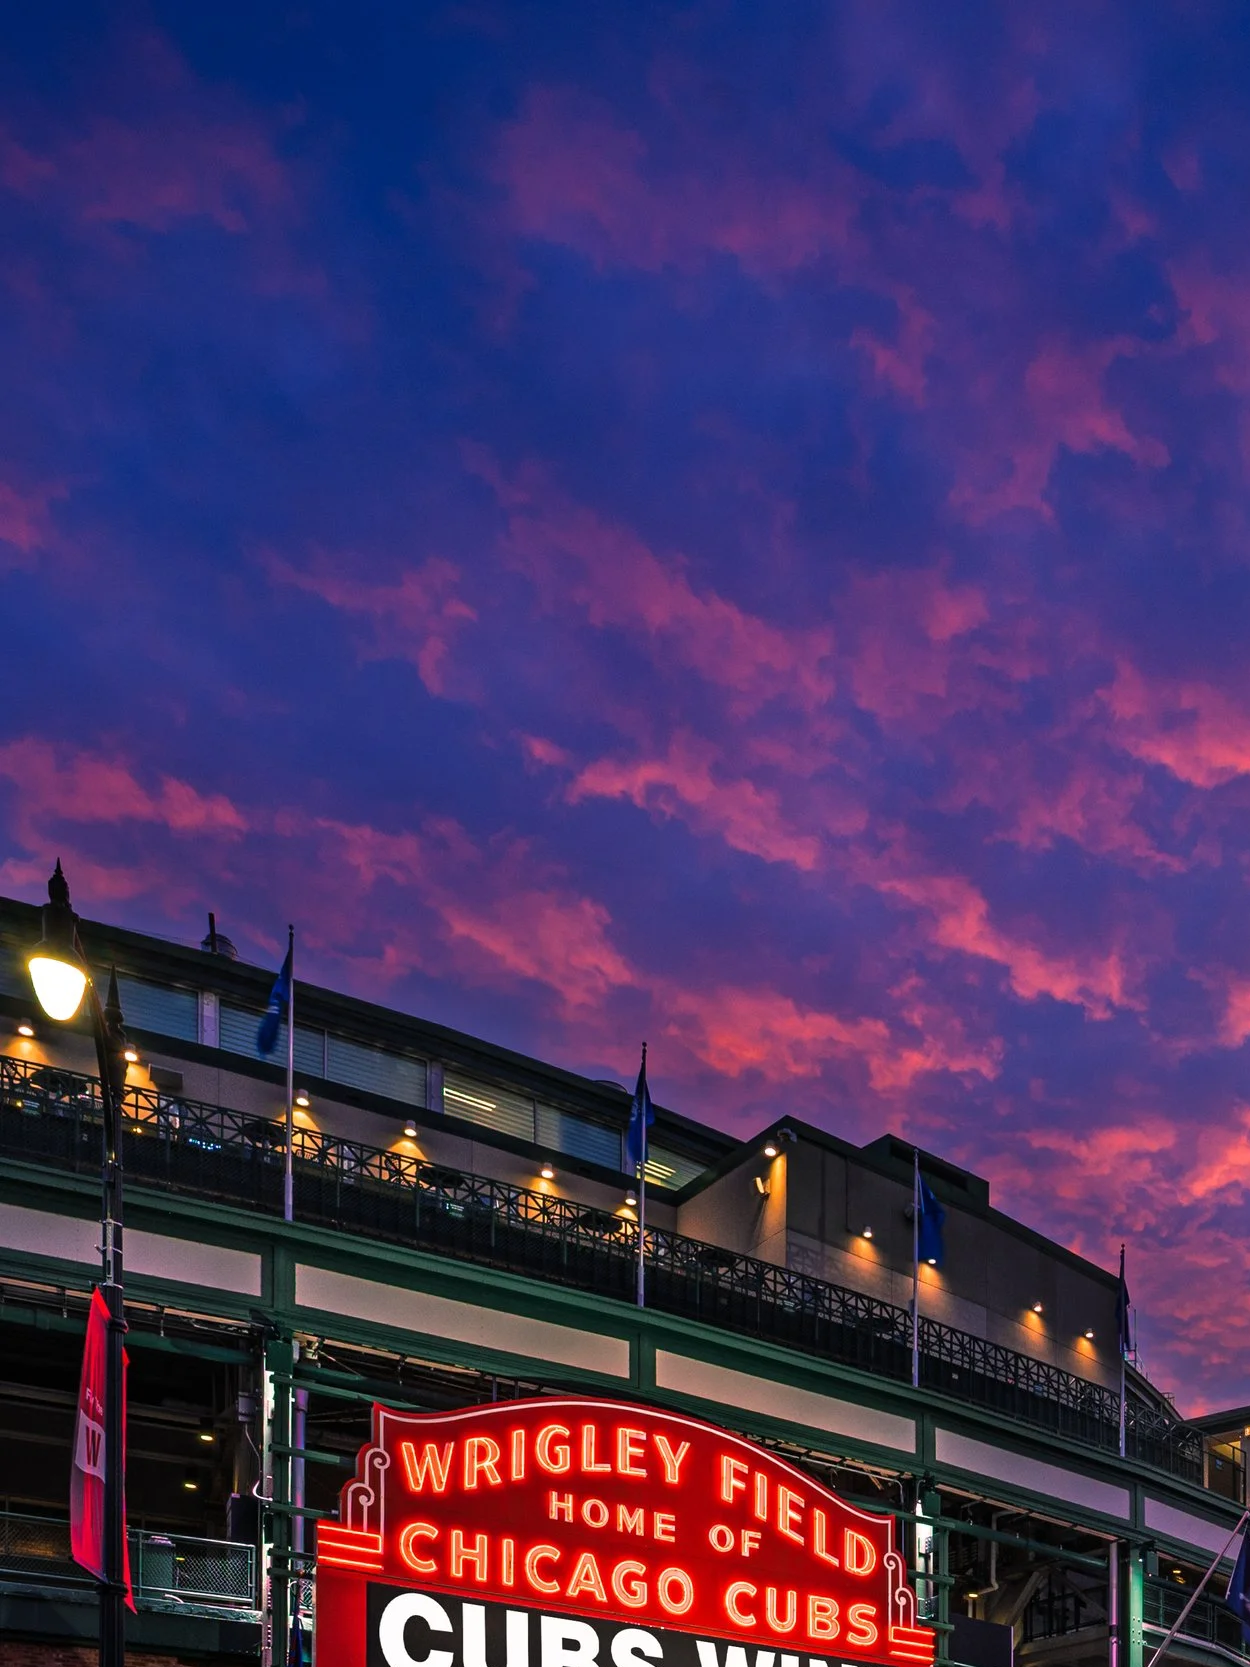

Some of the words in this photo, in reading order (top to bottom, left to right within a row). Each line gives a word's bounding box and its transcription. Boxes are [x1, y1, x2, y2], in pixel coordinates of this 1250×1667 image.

[86, 1425, 101, 1467] W
[401, 1423, 690, 1492] WRIGLEY
[719, 1453, 877, 1577] FIELD
[549, 1490, 676, 1543] HOME
[709, 1523, 762, 1557] OF
[398, 1522, 694, 1615] CHICAGO
[725, 1581, 877, 1645] CUBS
